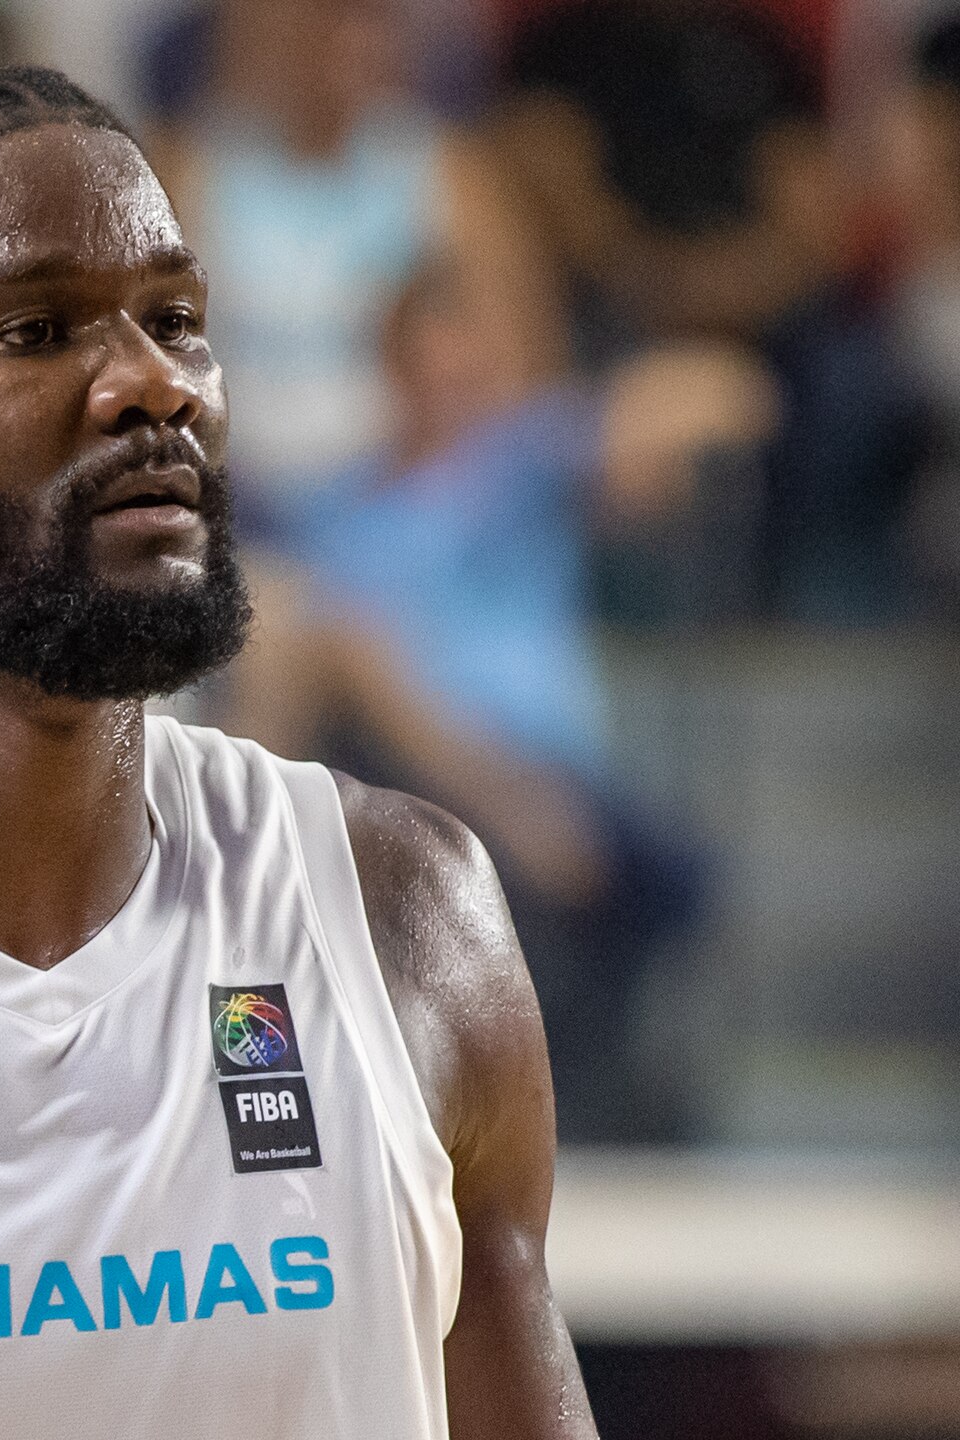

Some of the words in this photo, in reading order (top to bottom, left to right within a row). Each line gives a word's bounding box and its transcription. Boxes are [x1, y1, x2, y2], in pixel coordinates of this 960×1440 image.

[236, 1090, 299, 1122] FIBA
[240, 1151, 255, 1160] We
[256, 1150, 270, 1159] Are
[270, 1145, 311, 1158] Basketball
